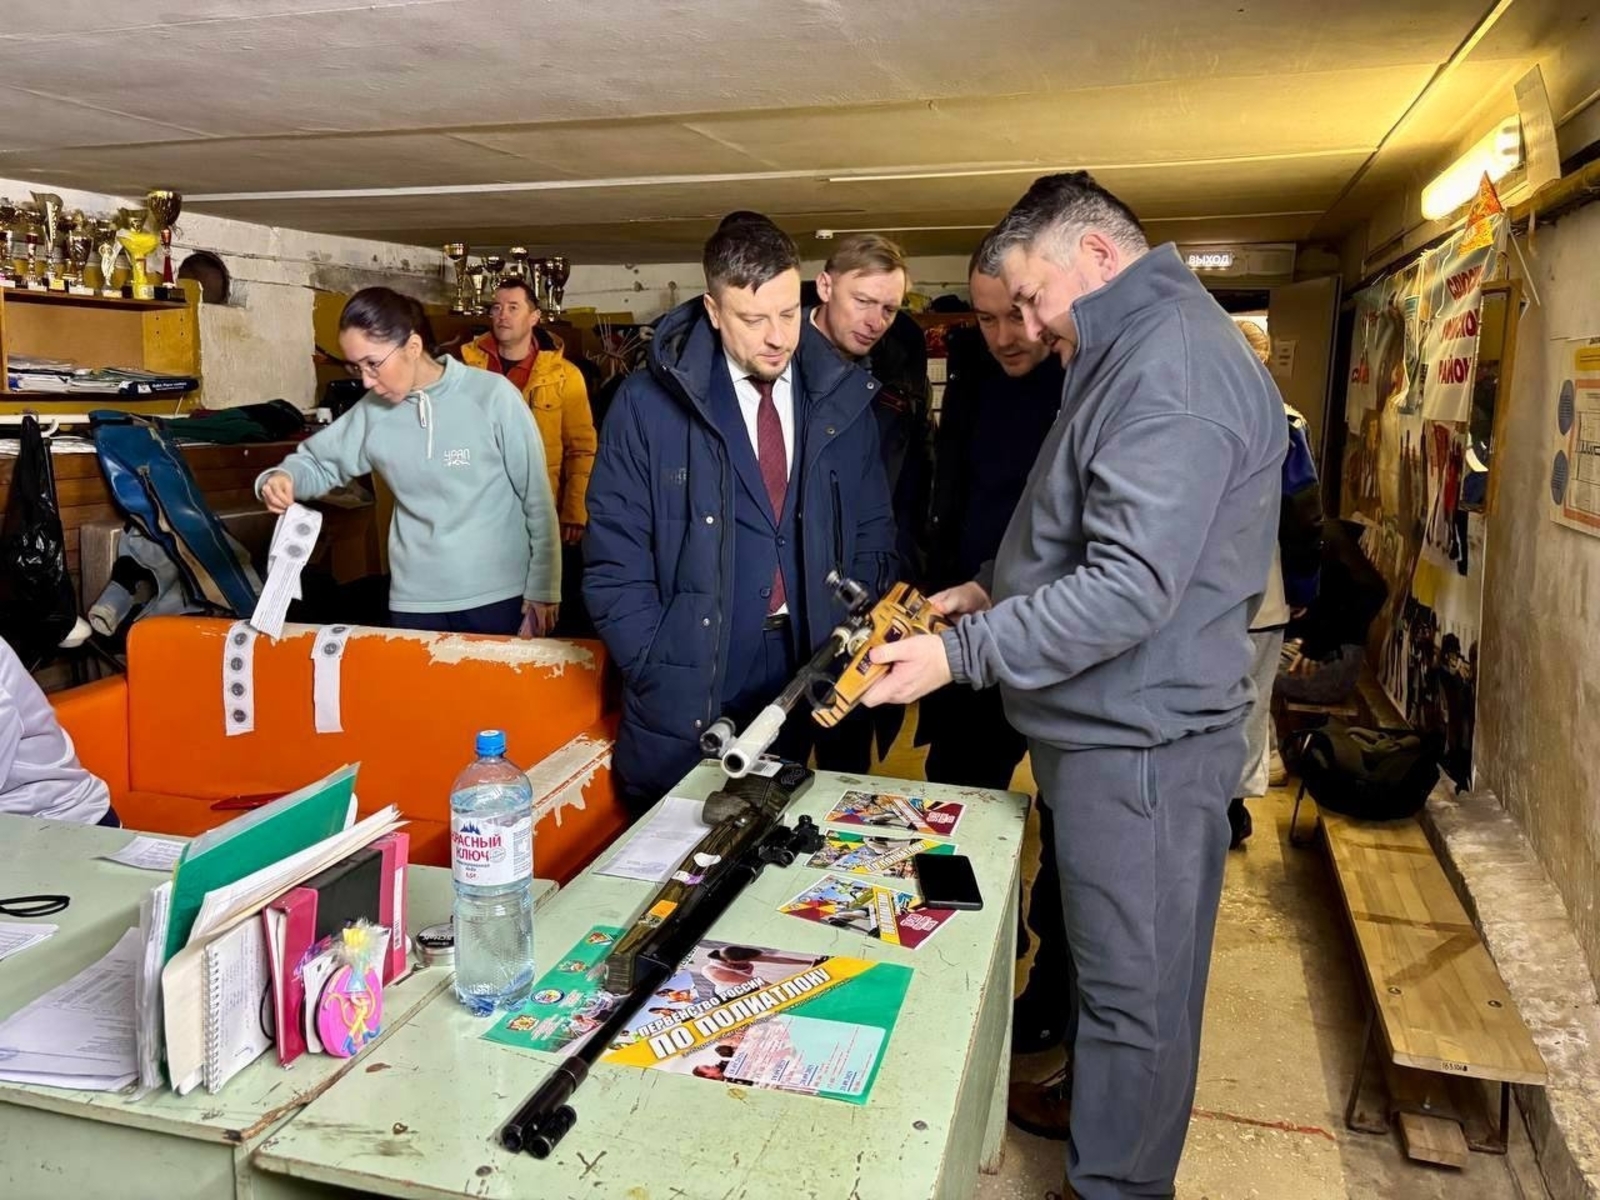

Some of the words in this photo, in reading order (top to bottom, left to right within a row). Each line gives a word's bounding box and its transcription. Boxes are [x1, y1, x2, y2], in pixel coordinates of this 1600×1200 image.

[1187, 254, 1230, 266] ВЫХОД
[456, 846, 490, 862] КЛЮЧ
[637, 995, 721, 1037] ПЕРВЕНСТВО
[718, 975, 766, 1002] РОССИИ
[647, 1026, 696, 1060] ПО
[692, 966, 832, 1037] ПОЛИАТЛОНУ
